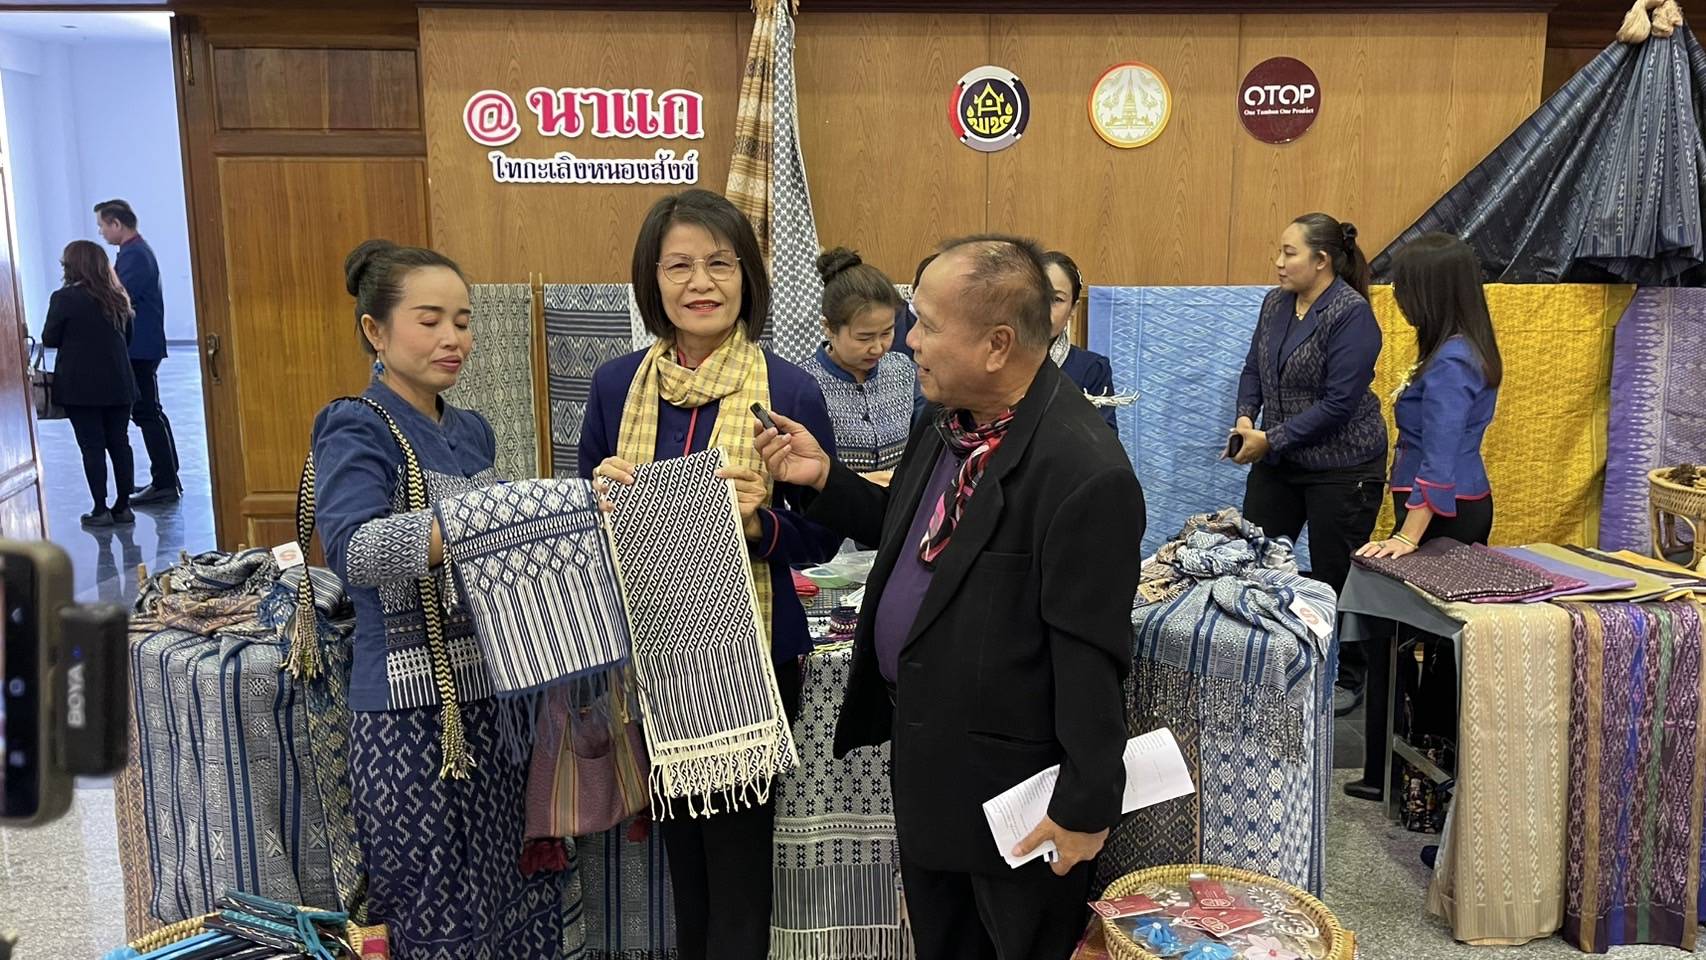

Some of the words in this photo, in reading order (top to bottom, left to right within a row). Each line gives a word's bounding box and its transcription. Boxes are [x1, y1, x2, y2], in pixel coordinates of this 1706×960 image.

[529, 91, 702, 135] นาแก
[1244, 84, 1315, 106] OTOP
[67, 663, 86, 728] BOYA
